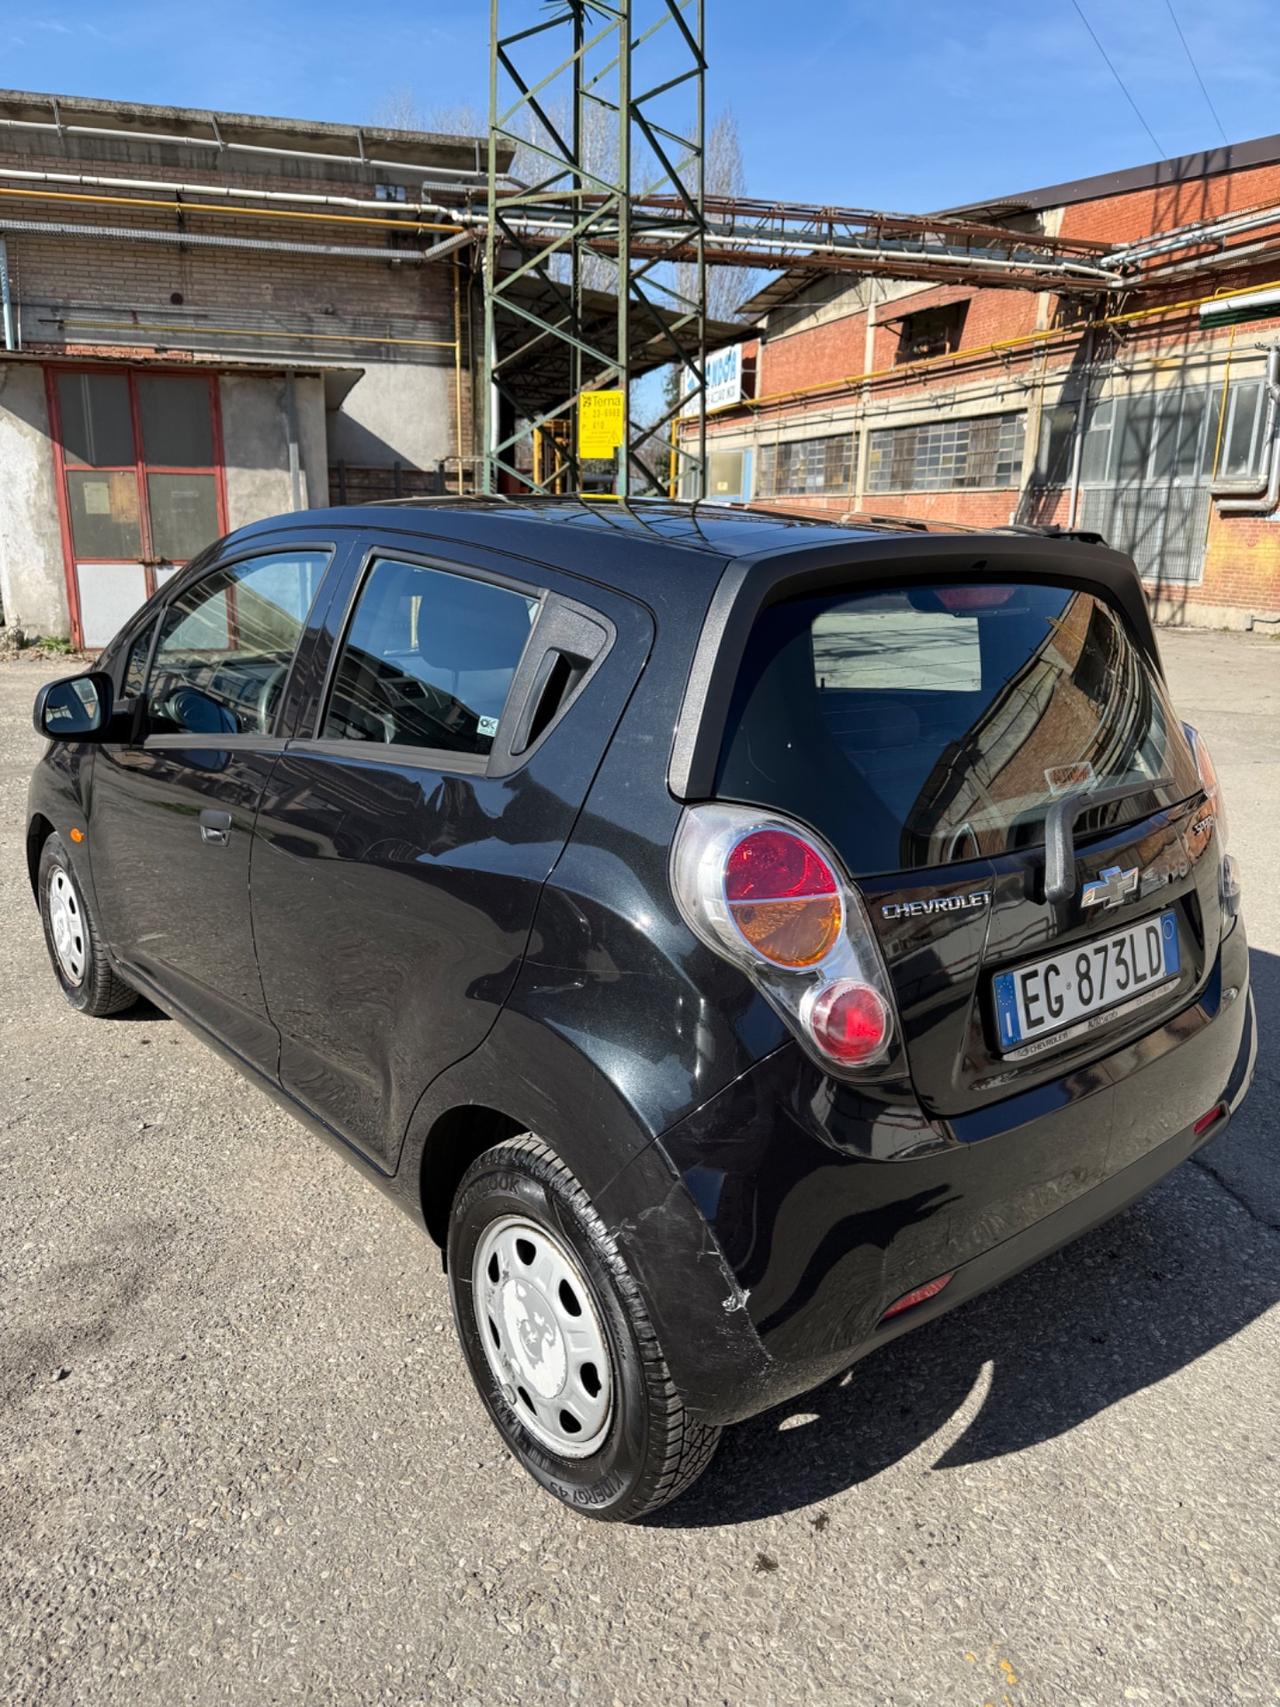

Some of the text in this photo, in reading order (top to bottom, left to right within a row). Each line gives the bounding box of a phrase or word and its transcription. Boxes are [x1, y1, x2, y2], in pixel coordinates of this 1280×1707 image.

[593, 396, 621, 407] Terna
[882, 890, 991, 919] CHEVROLET
[1020, 925, 1162, 1030] EG 873LD
